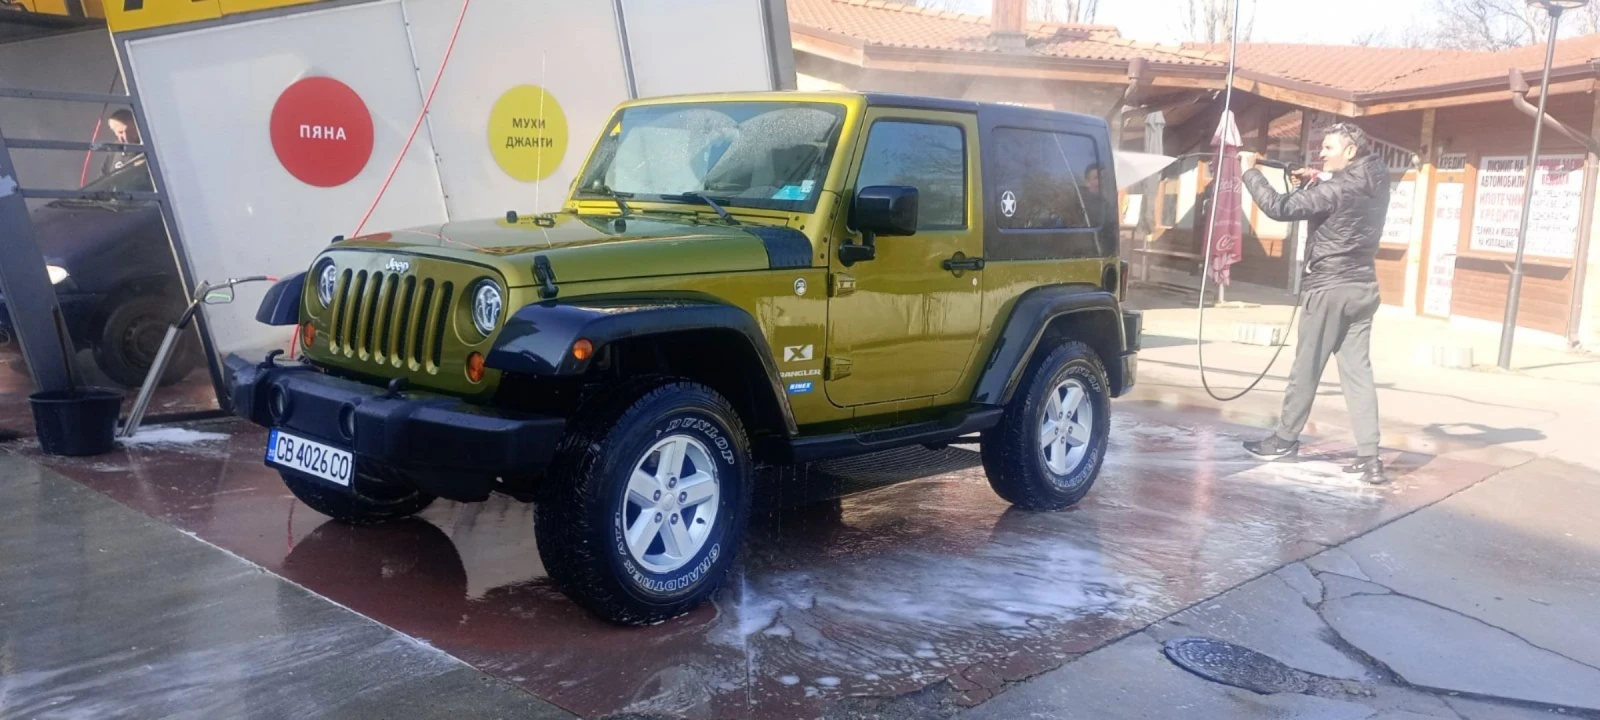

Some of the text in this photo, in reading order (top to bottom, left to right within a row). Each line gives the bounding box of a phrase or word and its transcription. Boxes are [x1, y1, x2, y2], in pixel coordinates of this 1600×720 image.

[512, 117, 546, 130] МУХИ
[299, 124, 347, 141] ПЯНА
[505, 136, 553, 149] ДЖАНТИ
[1515, 158, 1525, 171] НА
[386, 257, 409, 274] Jeep
[780, 369, 821, 378] RANGLER
[666, 417, 735, 465] DUNLOP
[277, 436, 294, 463] CB
[296, 442, 328, 474] 4026
[330, 453, 349, 480] CO
[623, 542, 720, 592] GRANDTREK
